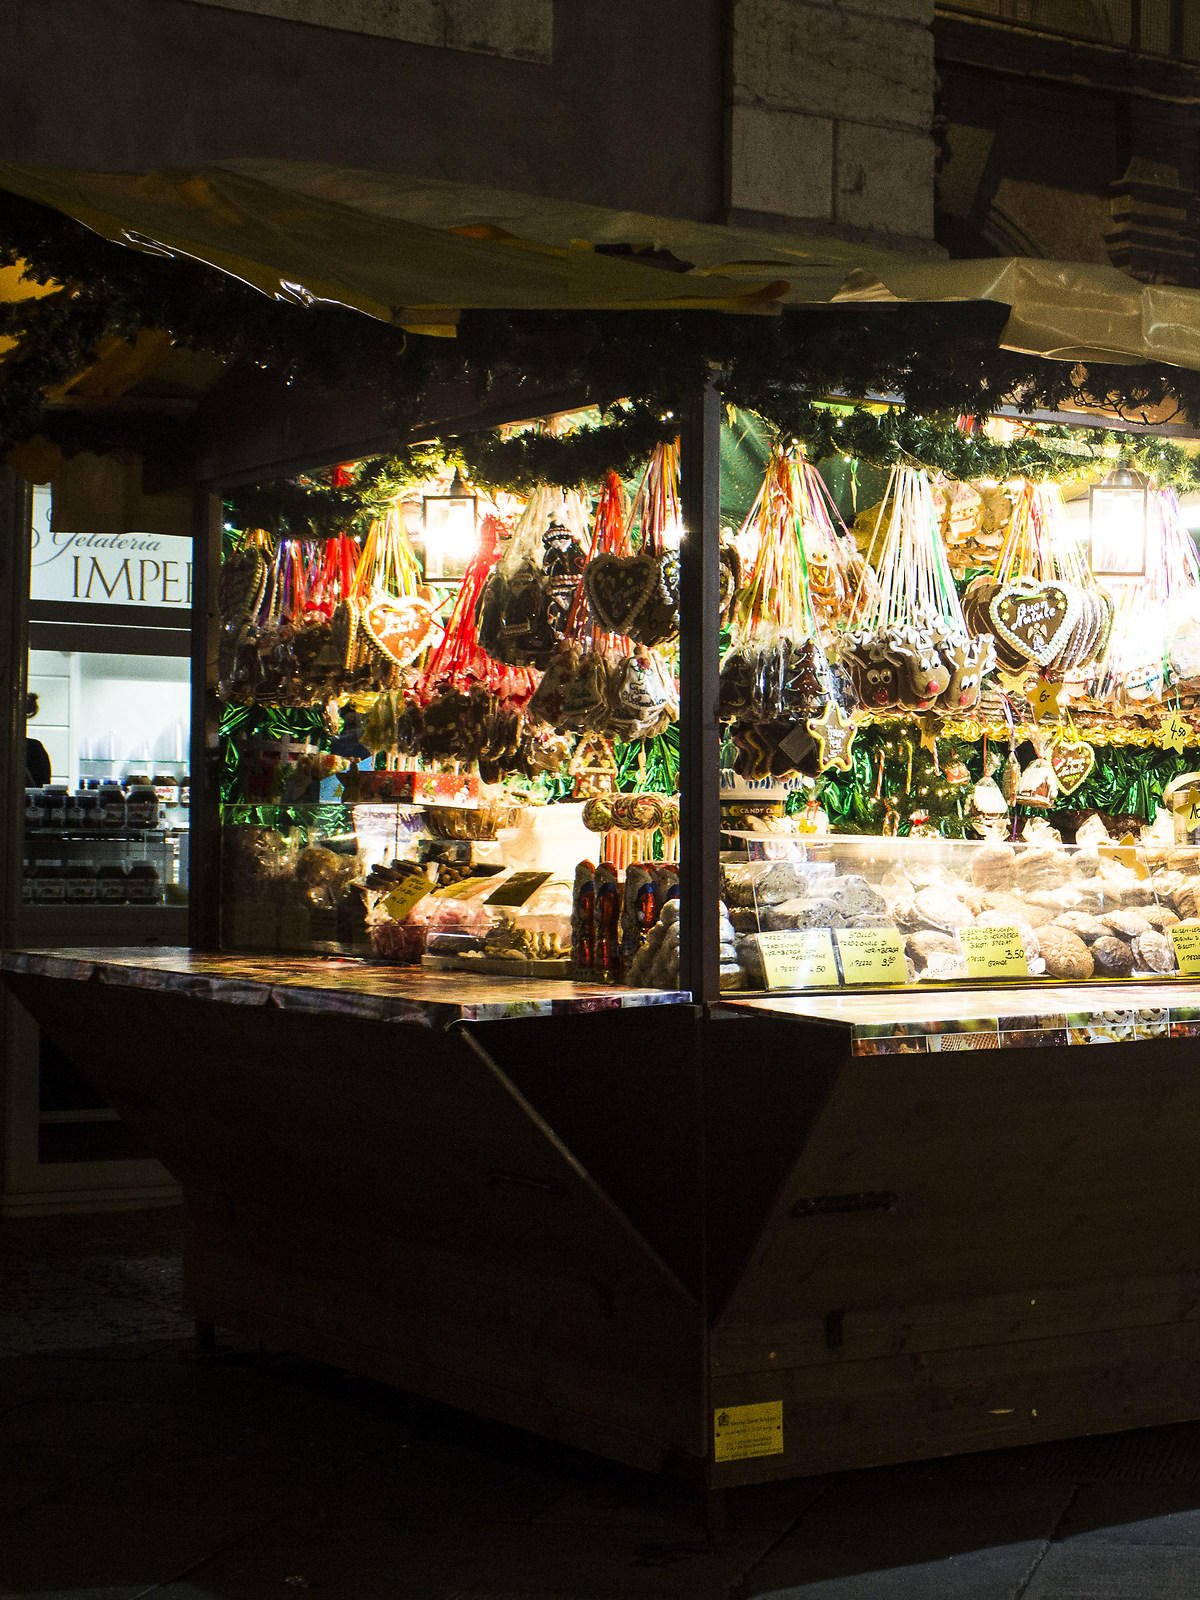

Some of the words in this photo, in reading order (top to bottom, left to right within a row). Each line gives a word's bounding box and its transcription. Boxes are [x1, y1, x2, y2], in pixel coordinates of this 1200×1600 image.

[1018, 601, 1049, 615] Buon
[1011, 607, 1056, 631] Natale
[1004, 949, 1025, 960] 3.50
